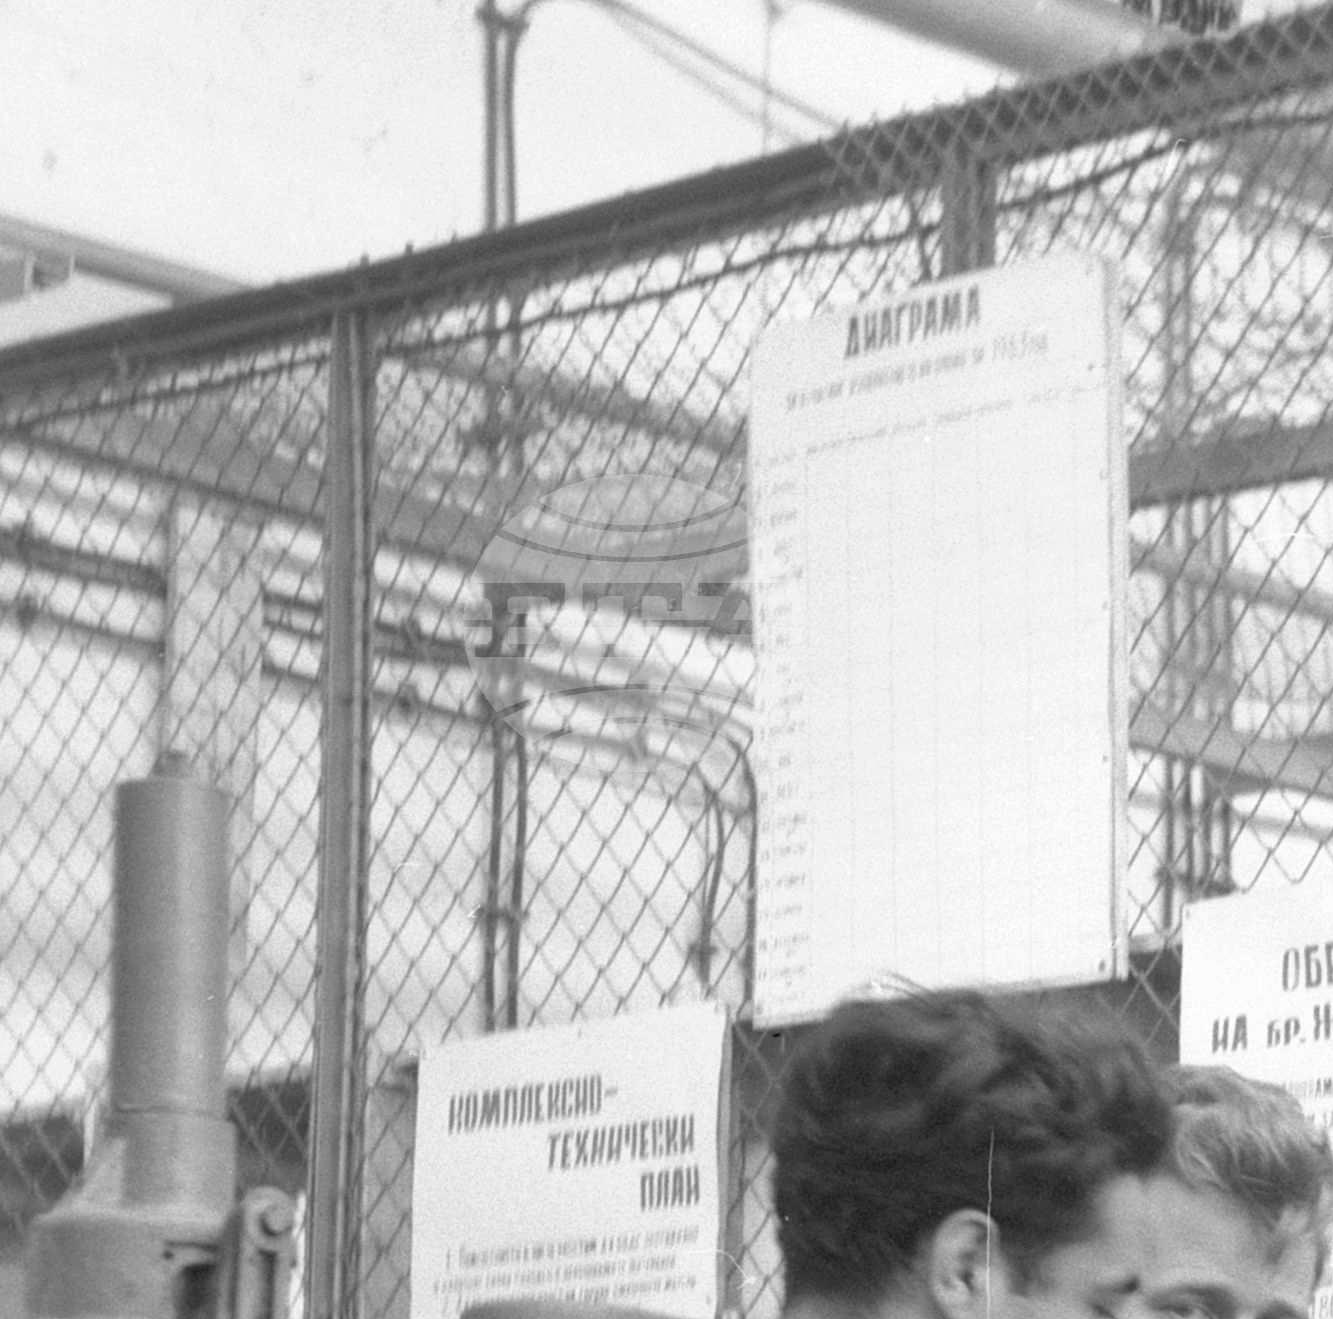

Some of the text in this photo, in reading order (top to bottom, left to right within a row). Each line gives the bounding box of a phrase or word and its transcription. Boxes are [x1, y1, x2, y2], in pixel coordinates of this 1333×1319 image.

[844, 284, 981, 360] ДИАГРАМА
[1211, 1014, 1249, 1054] НА
[548, 1114, 694, 1170] ТЕХНИЧЕСКИ
[640, 1163, 700, 1212] ПЛАН
